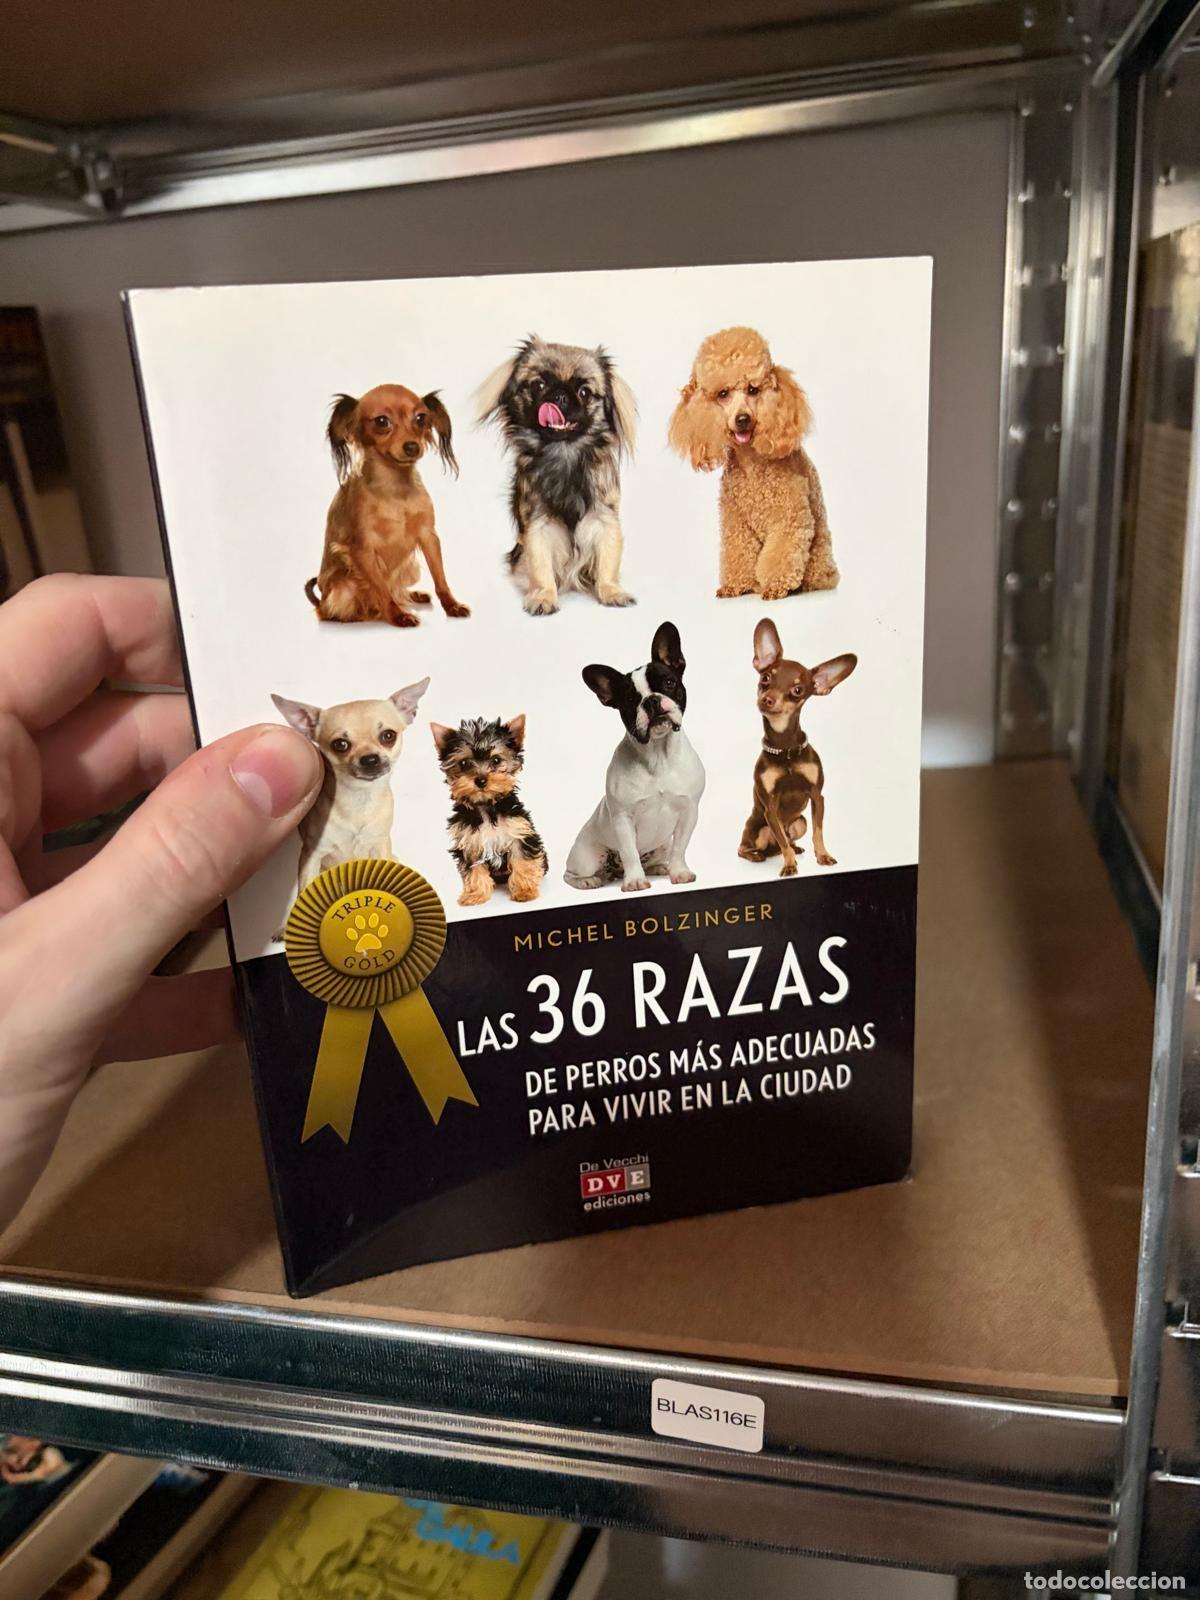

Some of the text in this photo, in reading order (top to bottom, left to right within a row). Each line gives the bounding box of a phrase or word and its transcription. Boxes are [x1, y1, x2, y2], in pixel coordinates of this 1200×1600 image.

[332, 895, 396, 921] TRIPLE
[514, 903, 774, 952] MICHEL BOLZINGER
[344, 949, 396, 971] GOLD
[457, 935, 850, 1057] LAS 36 RAZAS
[525, 1022, 877, 1097] DE PERROS MÁS ADECUADAS
[528, 1063, 853, 1136] PARA VIVIR EN LA CIUDAD
[579, 1153, 649, 1174] De Vecchi
[583, 1193, 651, 1212] ediciones
[657, 1397, 757, 1429] BLAS116E
